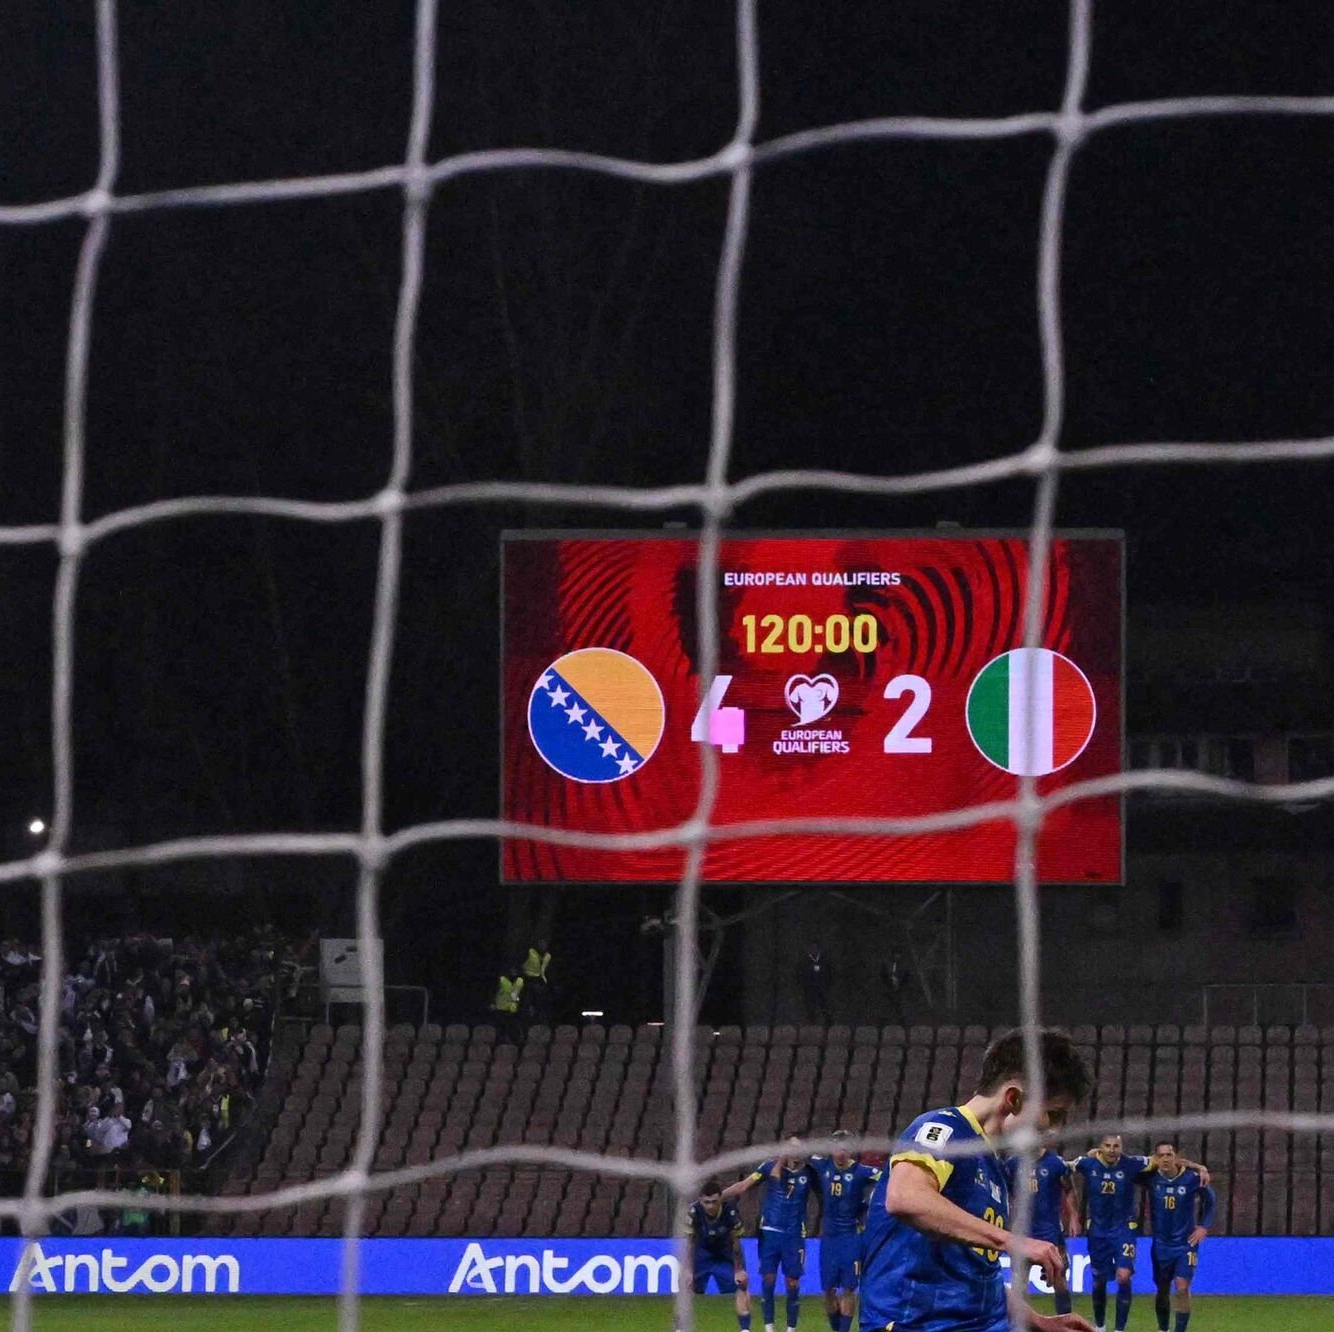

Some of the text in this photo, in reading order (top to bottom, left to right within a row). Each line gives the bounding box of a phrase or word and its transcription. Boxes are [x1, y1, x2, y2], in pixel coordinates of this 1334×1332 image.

[724, 572, 902, 587] EUROPEAN QUALIFIERS
[742, 614, 878, 653] 120:00
[883, 674, 933, 754] 2
[780, 730, 842, 741] EUROPEAN
[772, 741, 851, 755] QUALIFIERS
[830, 1182, 843, 1197] 19
[1163, 1195, 1176, 1210] 16
[9, 1242, 240, 1293] Antom
[448, 1242, 682, 1293] Antom
